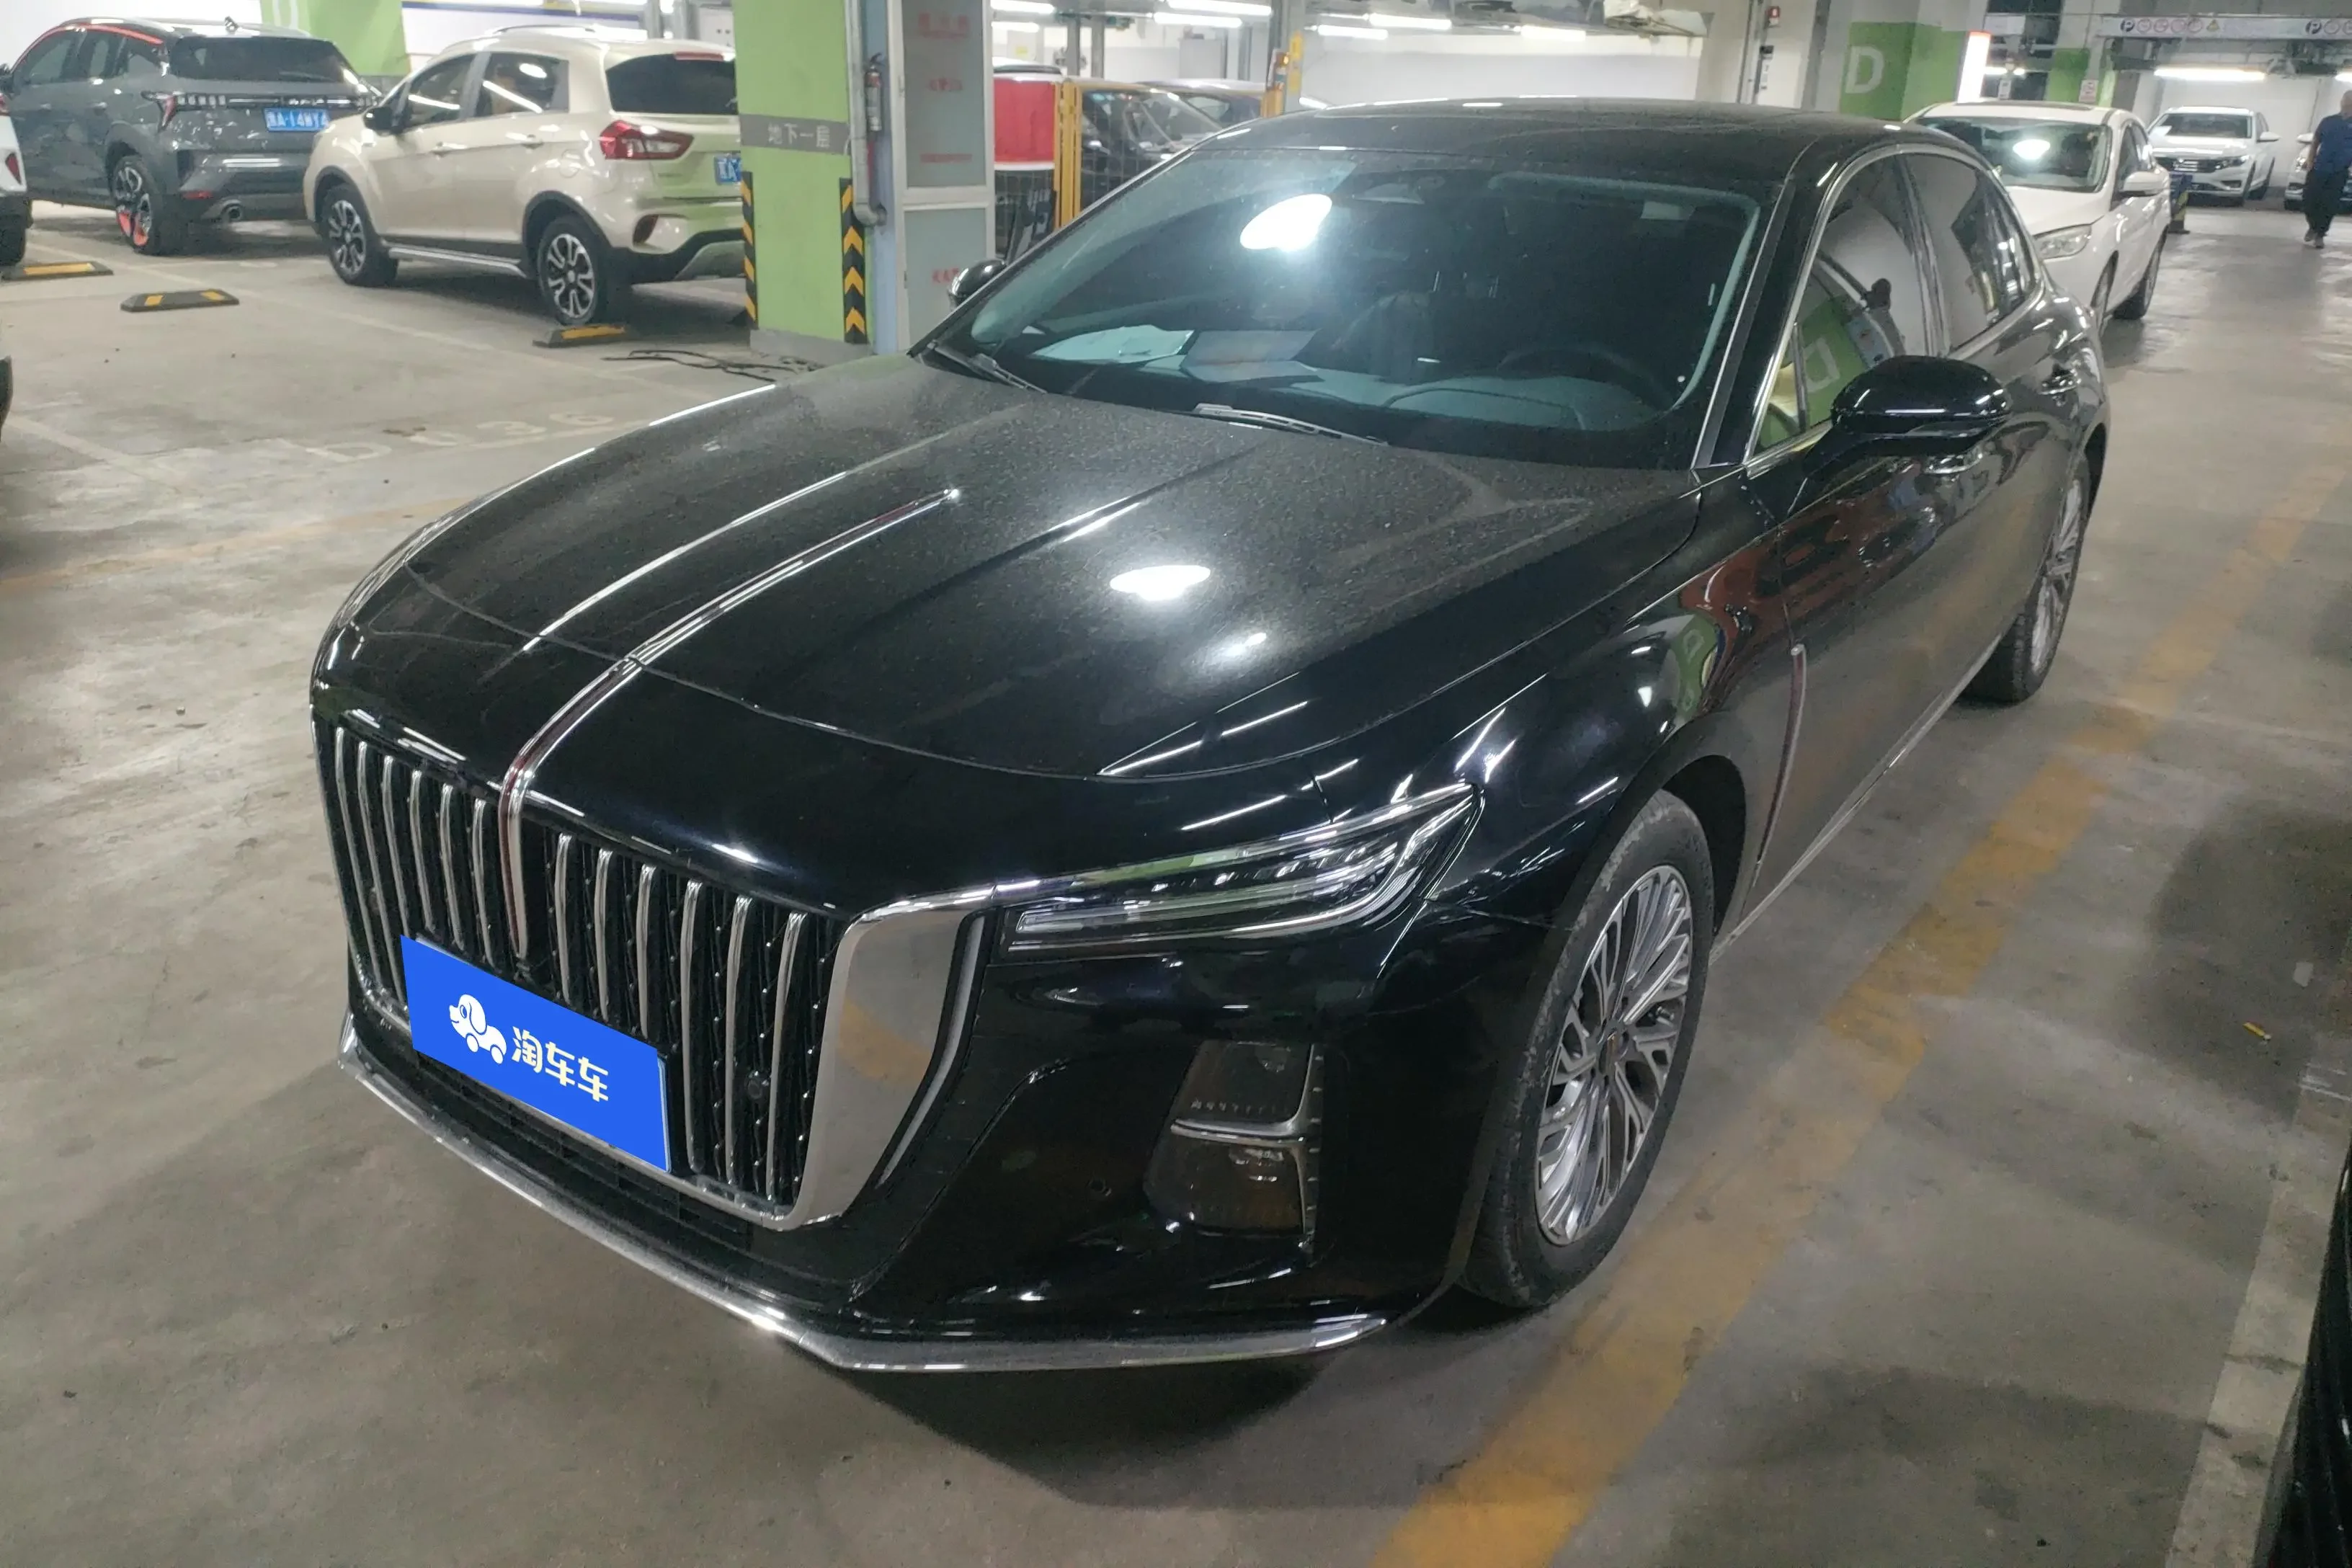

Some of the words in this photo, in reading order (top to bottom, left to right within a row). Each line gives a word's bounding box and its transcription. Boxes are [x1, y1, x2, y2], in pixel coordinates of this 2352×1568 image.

[1845, 45, 1884, 94] D
[767, 122, 830, 148] 地下一层
